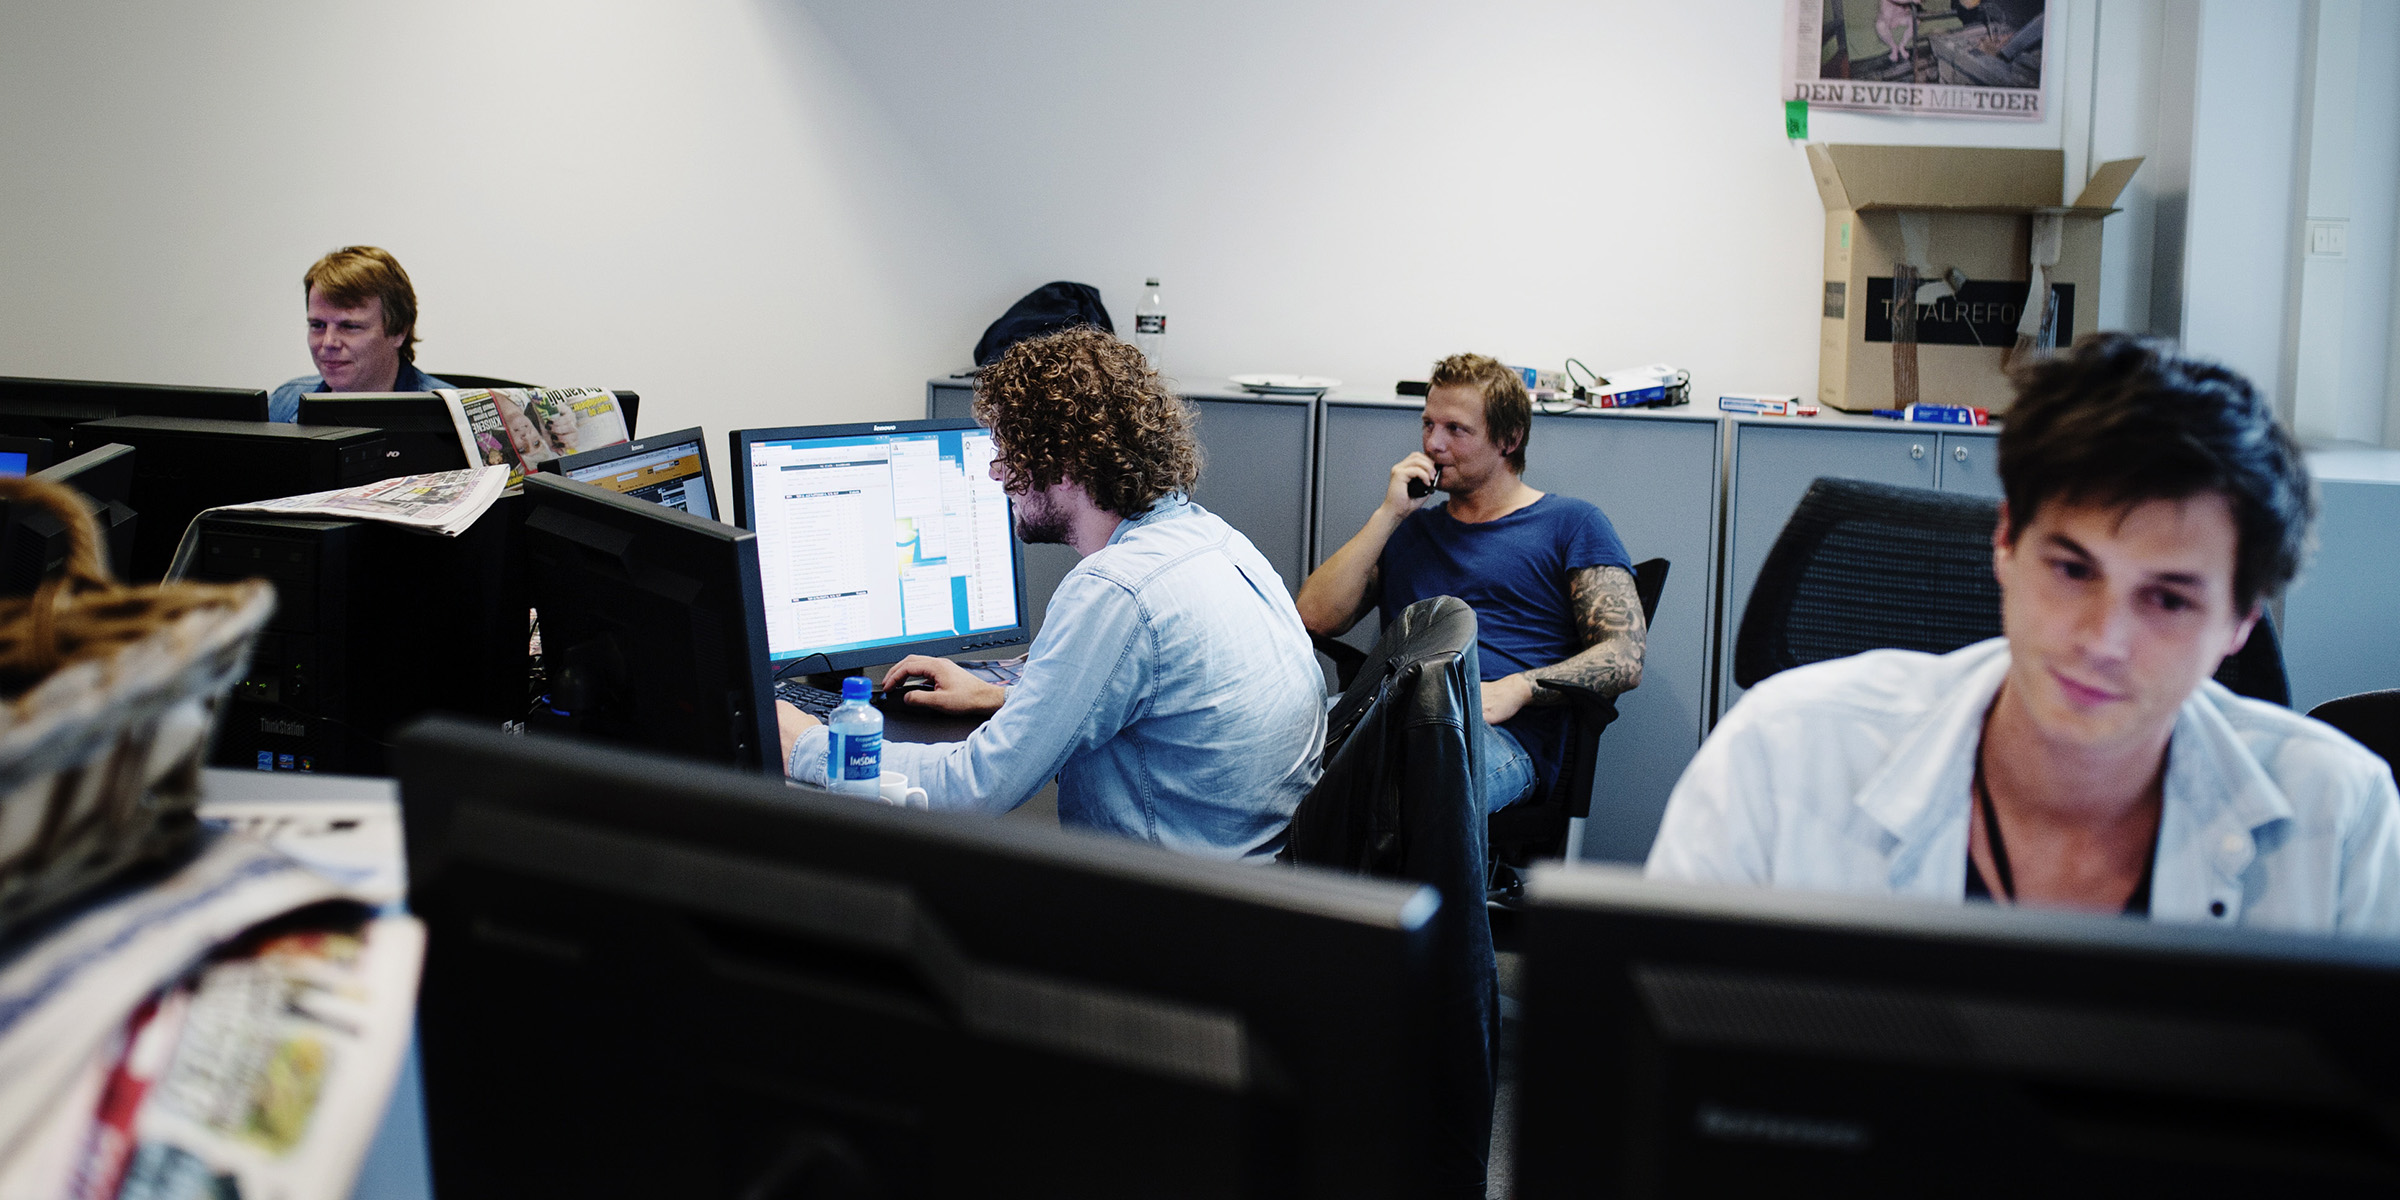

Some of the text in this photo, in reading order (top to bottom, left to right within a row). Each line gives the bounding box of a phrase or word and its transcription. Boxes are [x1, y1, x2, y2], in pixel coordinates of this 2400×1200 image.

[1794, 82, 1844, 103] DEN
[1851, 86, 1923, 106] EVIGE
[471, 415, 502, 434] KRISENE
[260, 717, 305, 737] ThinkStation
